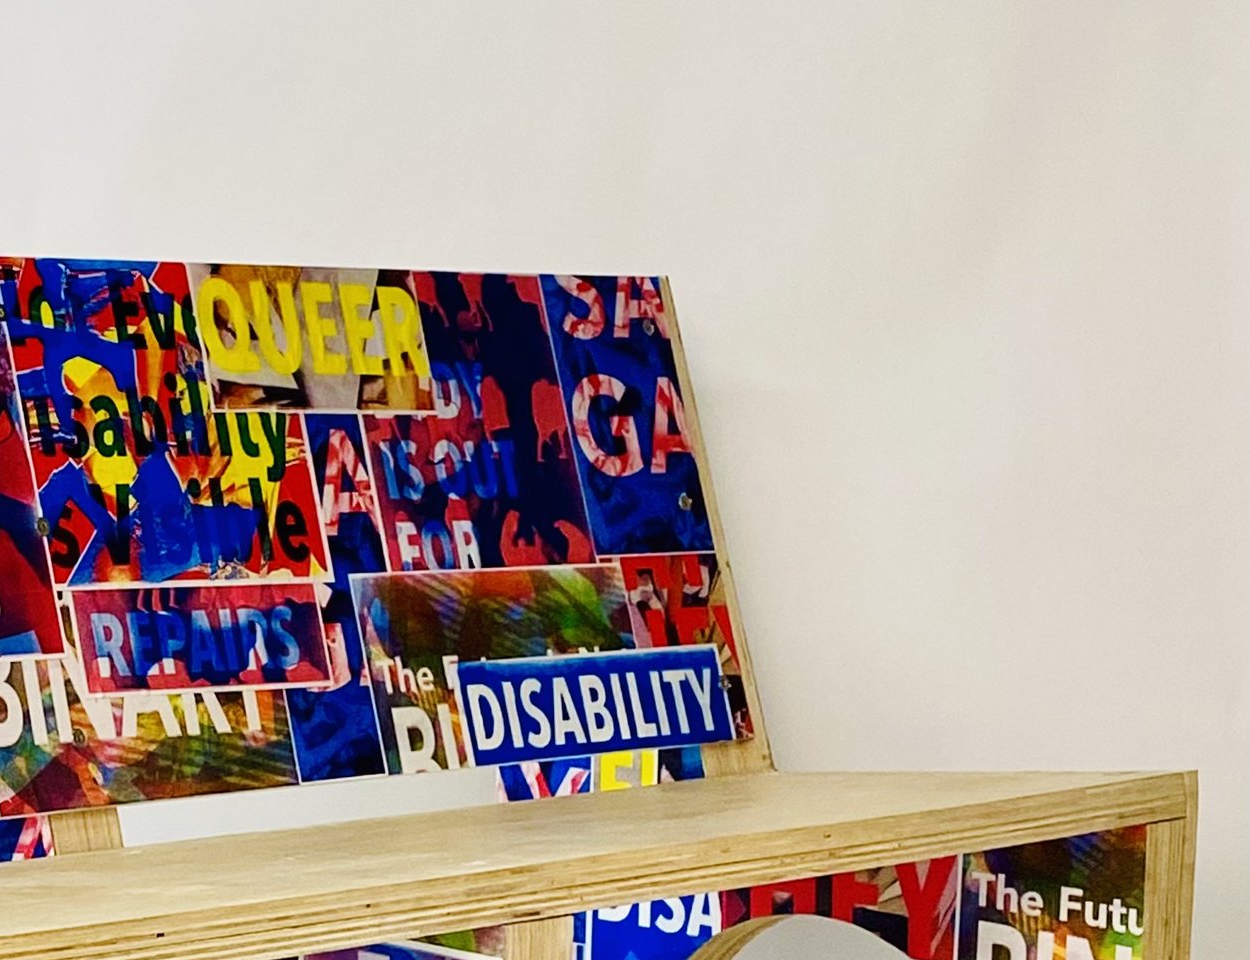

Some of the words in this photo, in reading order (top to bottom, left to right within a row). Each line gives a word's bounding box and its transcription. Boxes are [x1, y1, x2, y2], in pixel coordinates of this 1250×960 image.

[196, 276, 427, 377] QUEER
[571, 373, 700, 478] GA
[395, 519, 482, 573] FOR
[90, 607, 300, 680] REPAIRS
[378, 655, 434, 695] The
[466, 668, 715, 751] DISABILITY
[969, 871, 1045, 918] The
